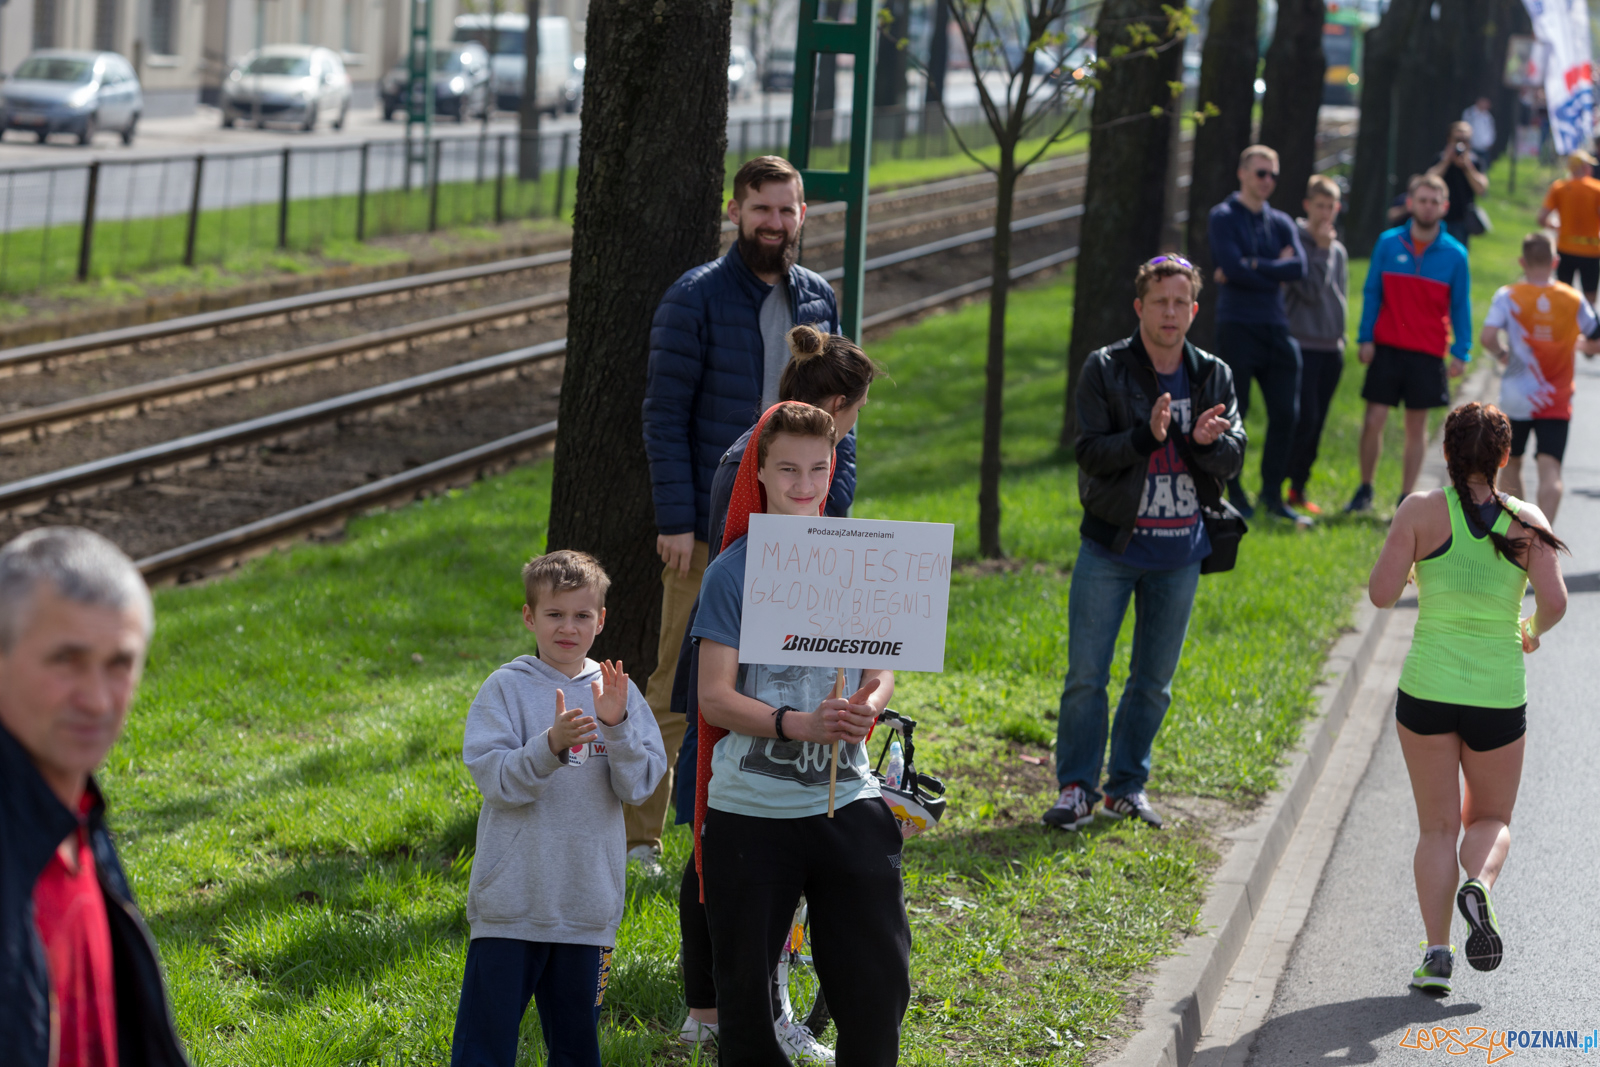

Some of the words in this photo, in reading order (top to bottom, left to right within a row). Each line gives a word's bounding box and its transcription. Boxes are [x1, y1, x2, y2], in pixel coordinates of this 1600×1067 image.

[807, 527, 895, 540] #PodazajZaMarzeniami
[1152, 526, 1191, 538] FOREVER
[762, 541, 837, 576] MAMO
[839, 547, 949, 589] JESTEM
[852, 588, 932, 619] BIEGNIJ
[808, 613, 892, 639] SZYBKO
[781, 634, 903, 656] BRIDGESTONE
